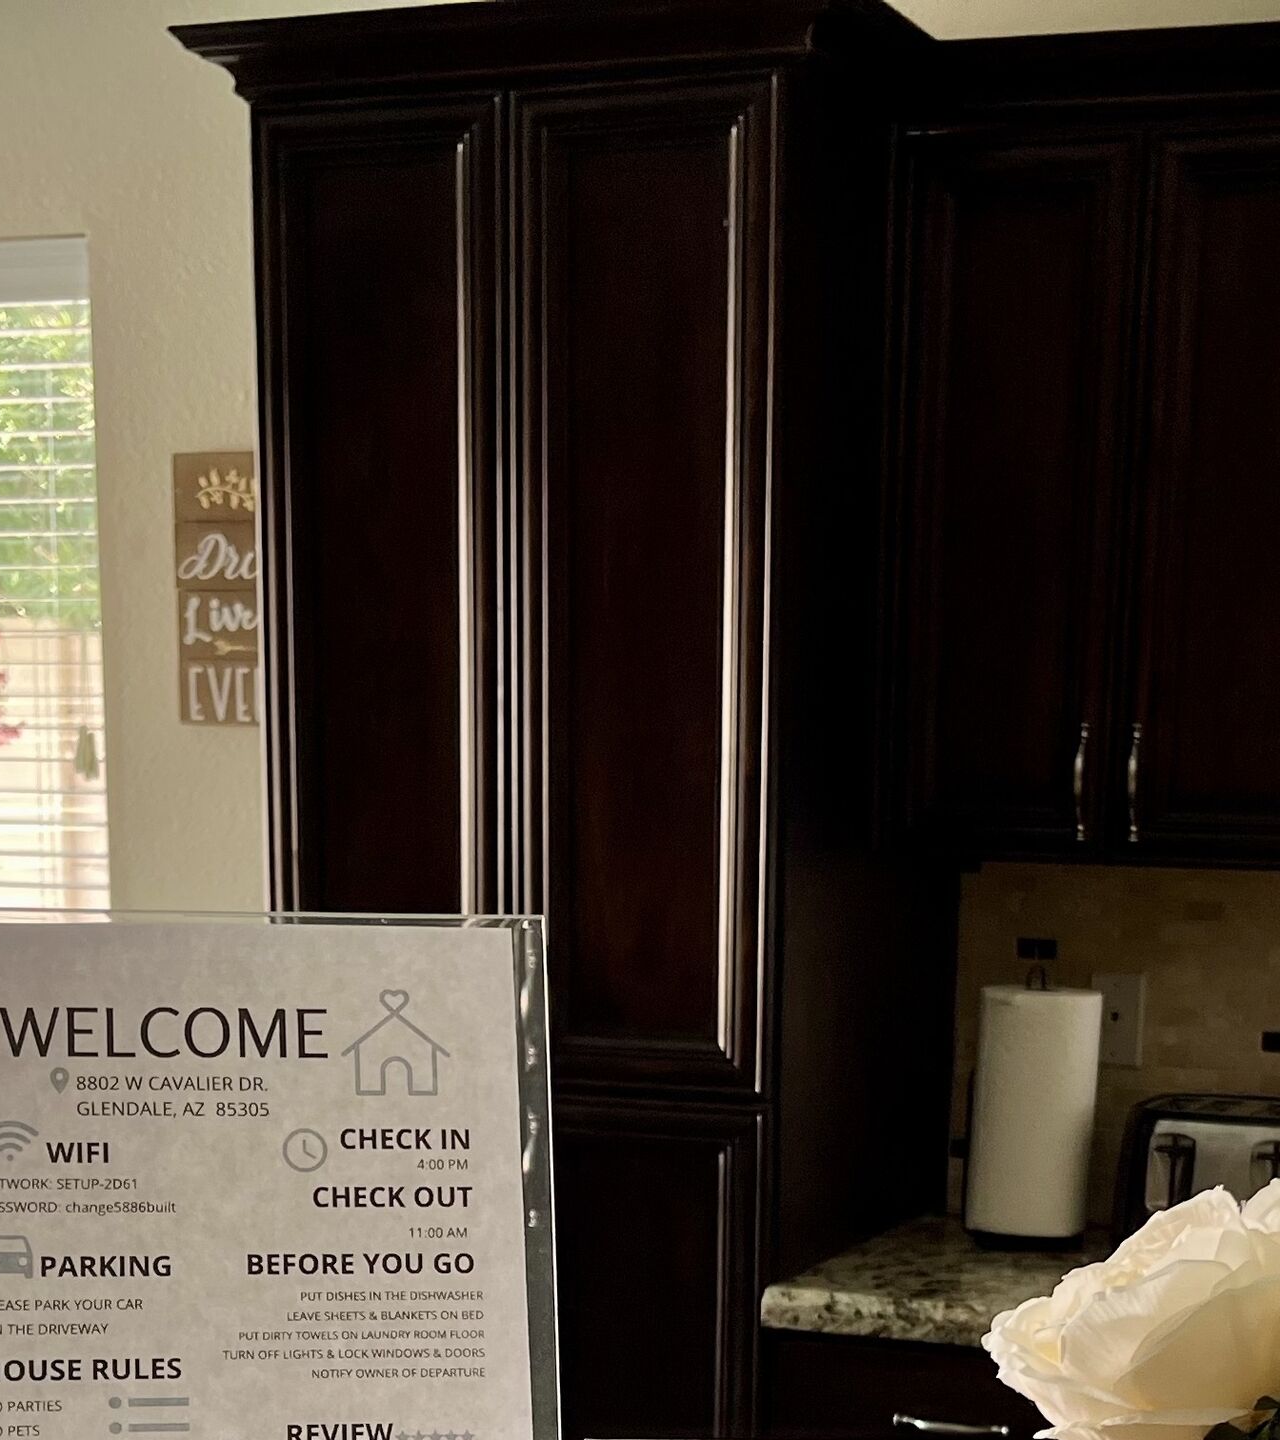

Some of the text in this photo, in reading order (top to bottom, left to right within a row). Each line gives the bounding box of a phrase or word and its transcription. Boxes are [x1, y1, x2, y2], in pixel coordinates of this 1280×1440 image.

[0, 1007, 328, 1058] WELCOME
[77, 1076, 267, 1091] 8802 W CAVALIER DR.
[77, 1102, 269, 1118] GLENDALE, AZ 85305
[341, 1129, 469, 1149] CHECK IN
[46, 1143, 108, 1163] WIFI
[417, 1159, 468, 1170] 4:00 PM
[57, 1179, 136, 1190] SETUP-2D61
[313, 1187, 472, 1207] CHECK OUT
[66, 1201, 176, 1216] change5886built
[409, 1227, 467, 1238] 11:00 AM
[41, 1256, 170, 1277] PARKING
[248, 1253, 474, 1275] BEFORE YOU GO
[301, 1291, 483, 1301] PUT DISHES IN THE DISHWASHER
[35, 1300, 70, 1310] PARK
[74, 1299, 112, 1310] YOUR
[117, 1299, 143, 1310] CAR
[8, 1324, 33, 1335] THE
[39, 1324, 108, 1335] DRIVEWAY
[93, 1358, 181, 1380] RULES
[8, 1400, 62, 1412] PARTIES
[8, 1425, 39, 1436] PETS
